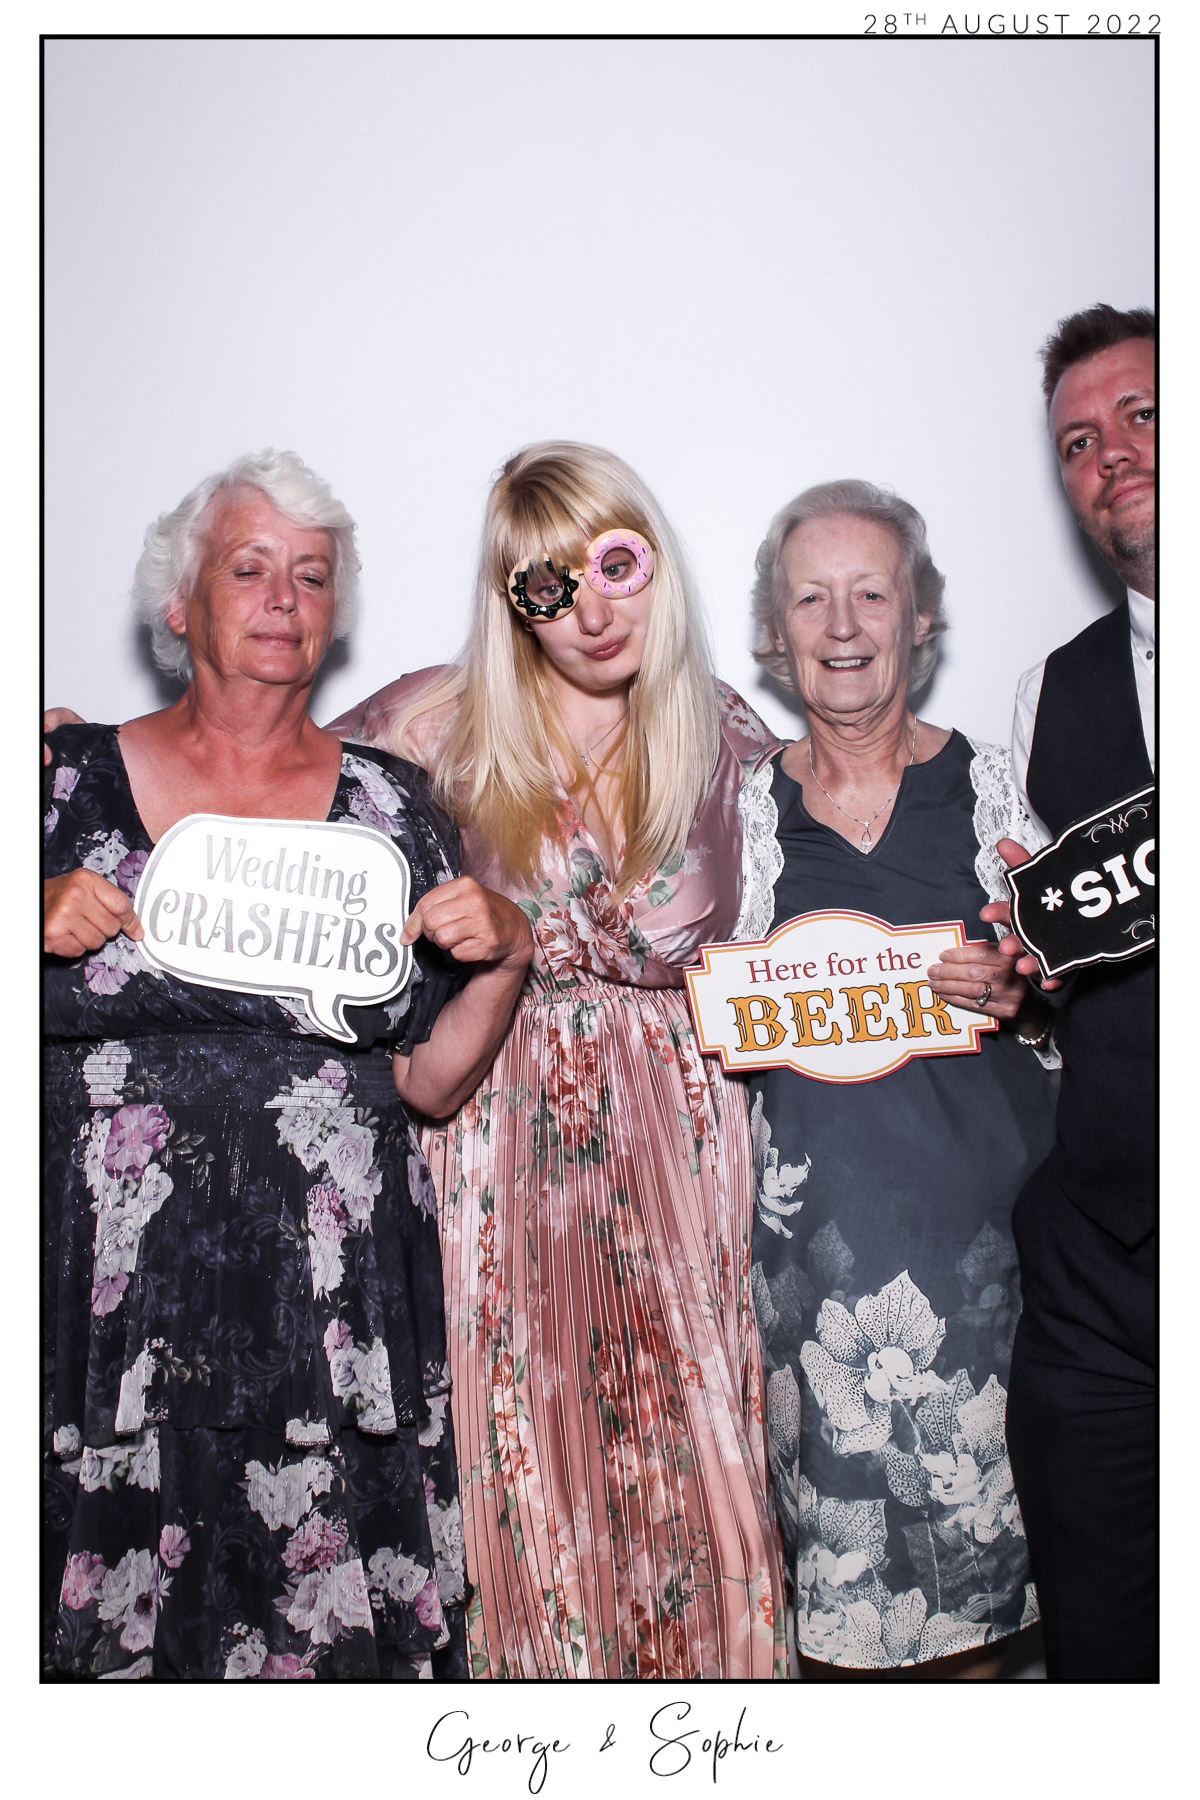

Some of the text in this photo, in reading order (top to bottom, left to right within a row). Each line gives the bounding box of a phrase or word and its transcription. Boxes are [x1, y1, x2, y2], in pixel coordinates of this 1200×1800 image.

[206, 834, 368, 915] Wedding
[149, 888, 399, 977] CRASHERS
[746, 947, 922, 984] Here for the
[726, 979, 962, 1052] BEER
